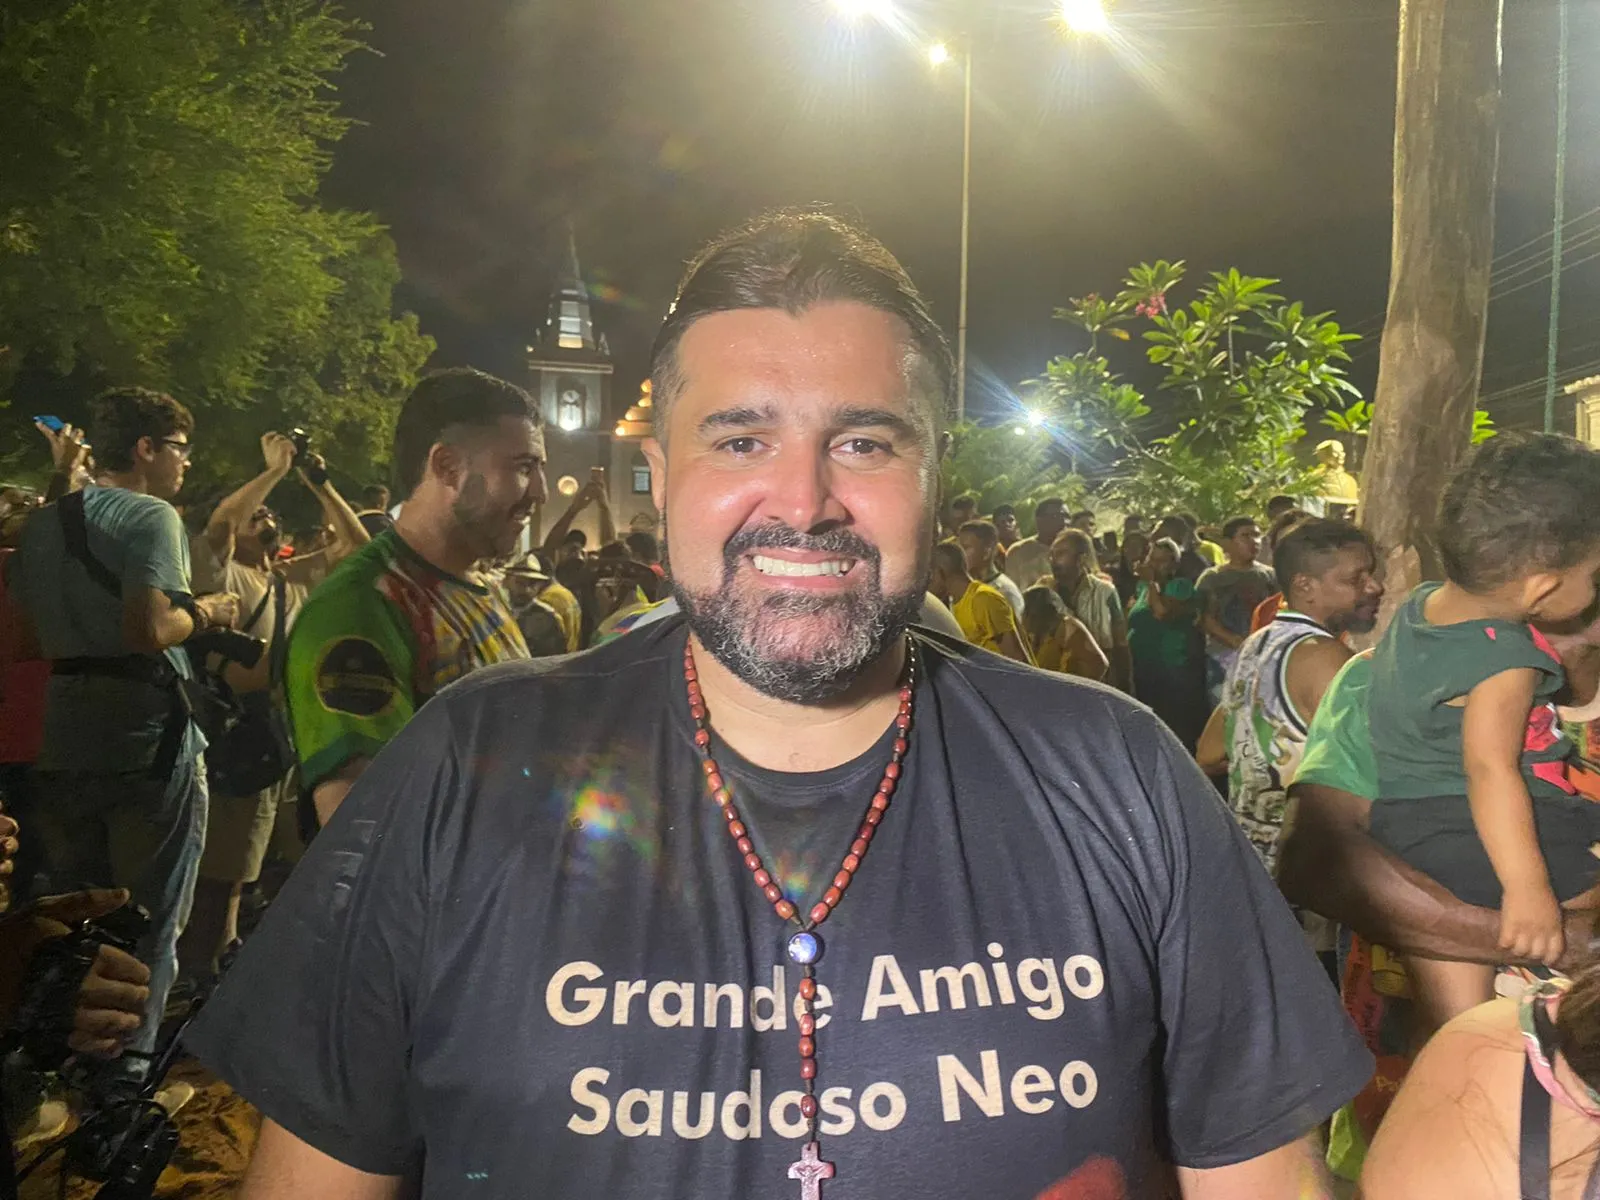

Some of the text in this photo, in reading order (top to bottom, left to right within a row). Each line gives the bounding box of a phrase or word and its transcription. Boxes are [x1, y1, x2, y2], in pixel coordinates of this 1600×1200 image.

[545, 941, 1105, 1034] Grande Amigo
[566, 1049, 1099, 1141] Saudoso Neo
